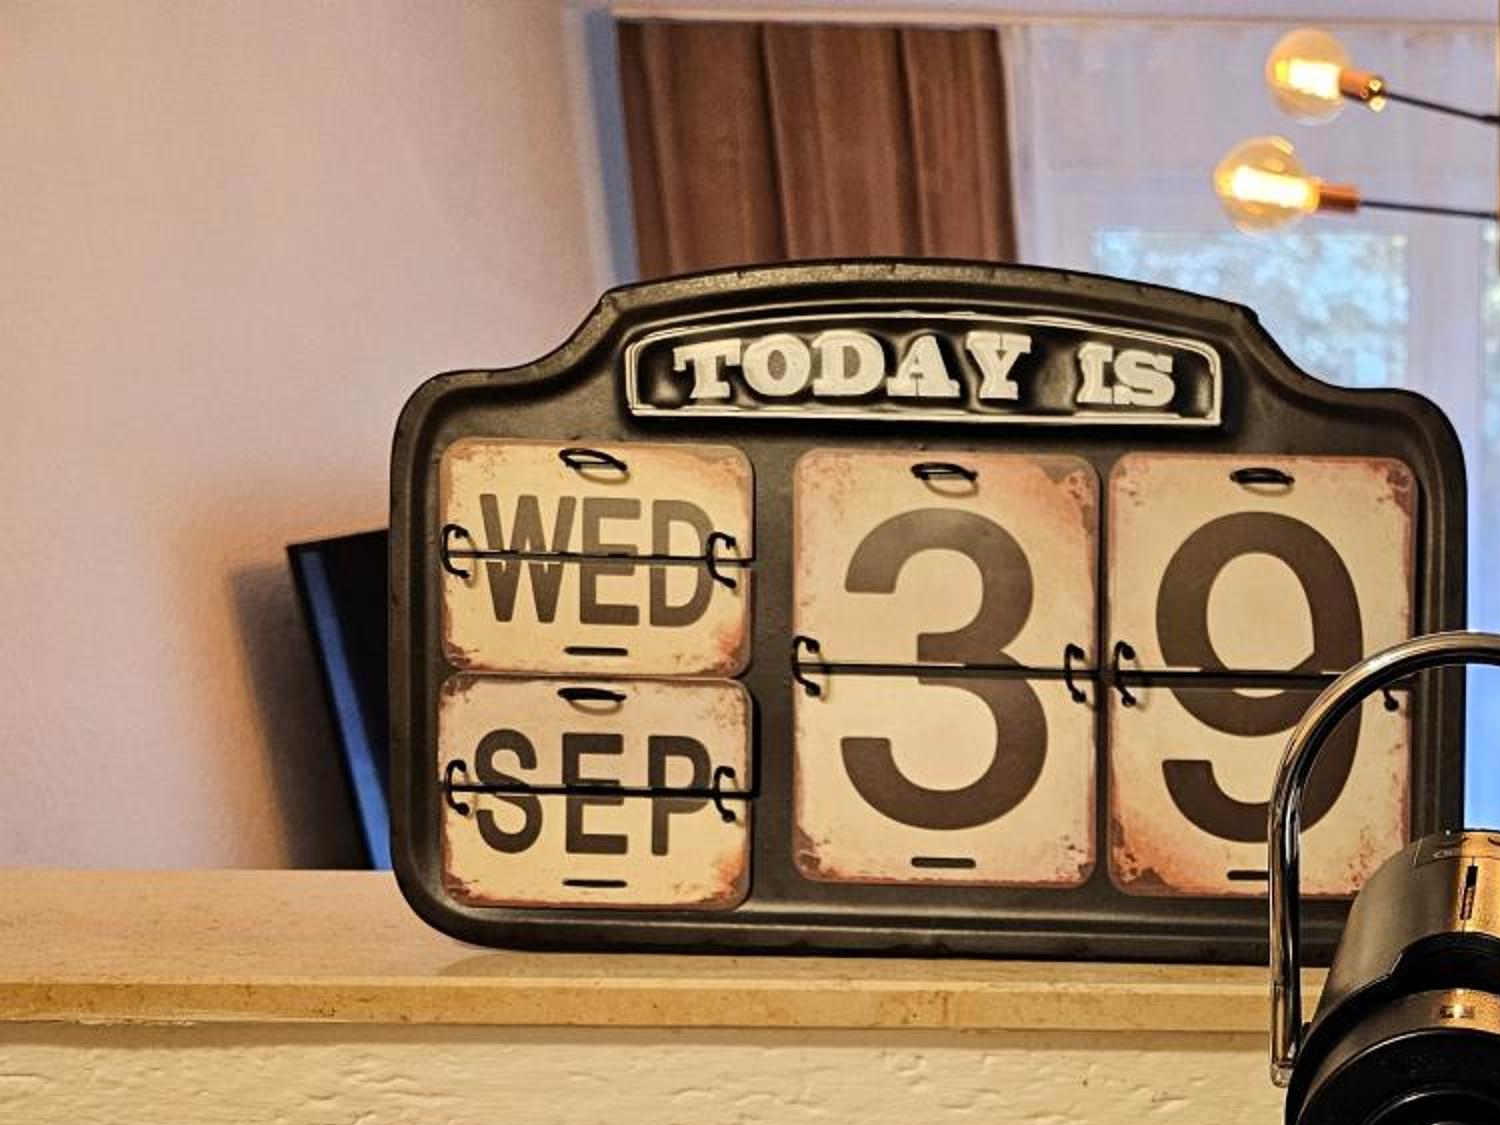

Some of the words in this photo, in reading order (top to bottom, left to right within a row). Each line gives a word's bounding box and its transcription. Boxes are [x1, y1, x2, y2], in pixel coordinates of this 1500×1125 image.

[673, 330, 1031, 400] TODAY
[1077, 341, 1175, 408] IS
[480, 493, 717, 627] WED
[840, 507, 1048, 831] 3
[1155, 511, 1364, 844] 9
[473, 729, 712, 857] SEP
